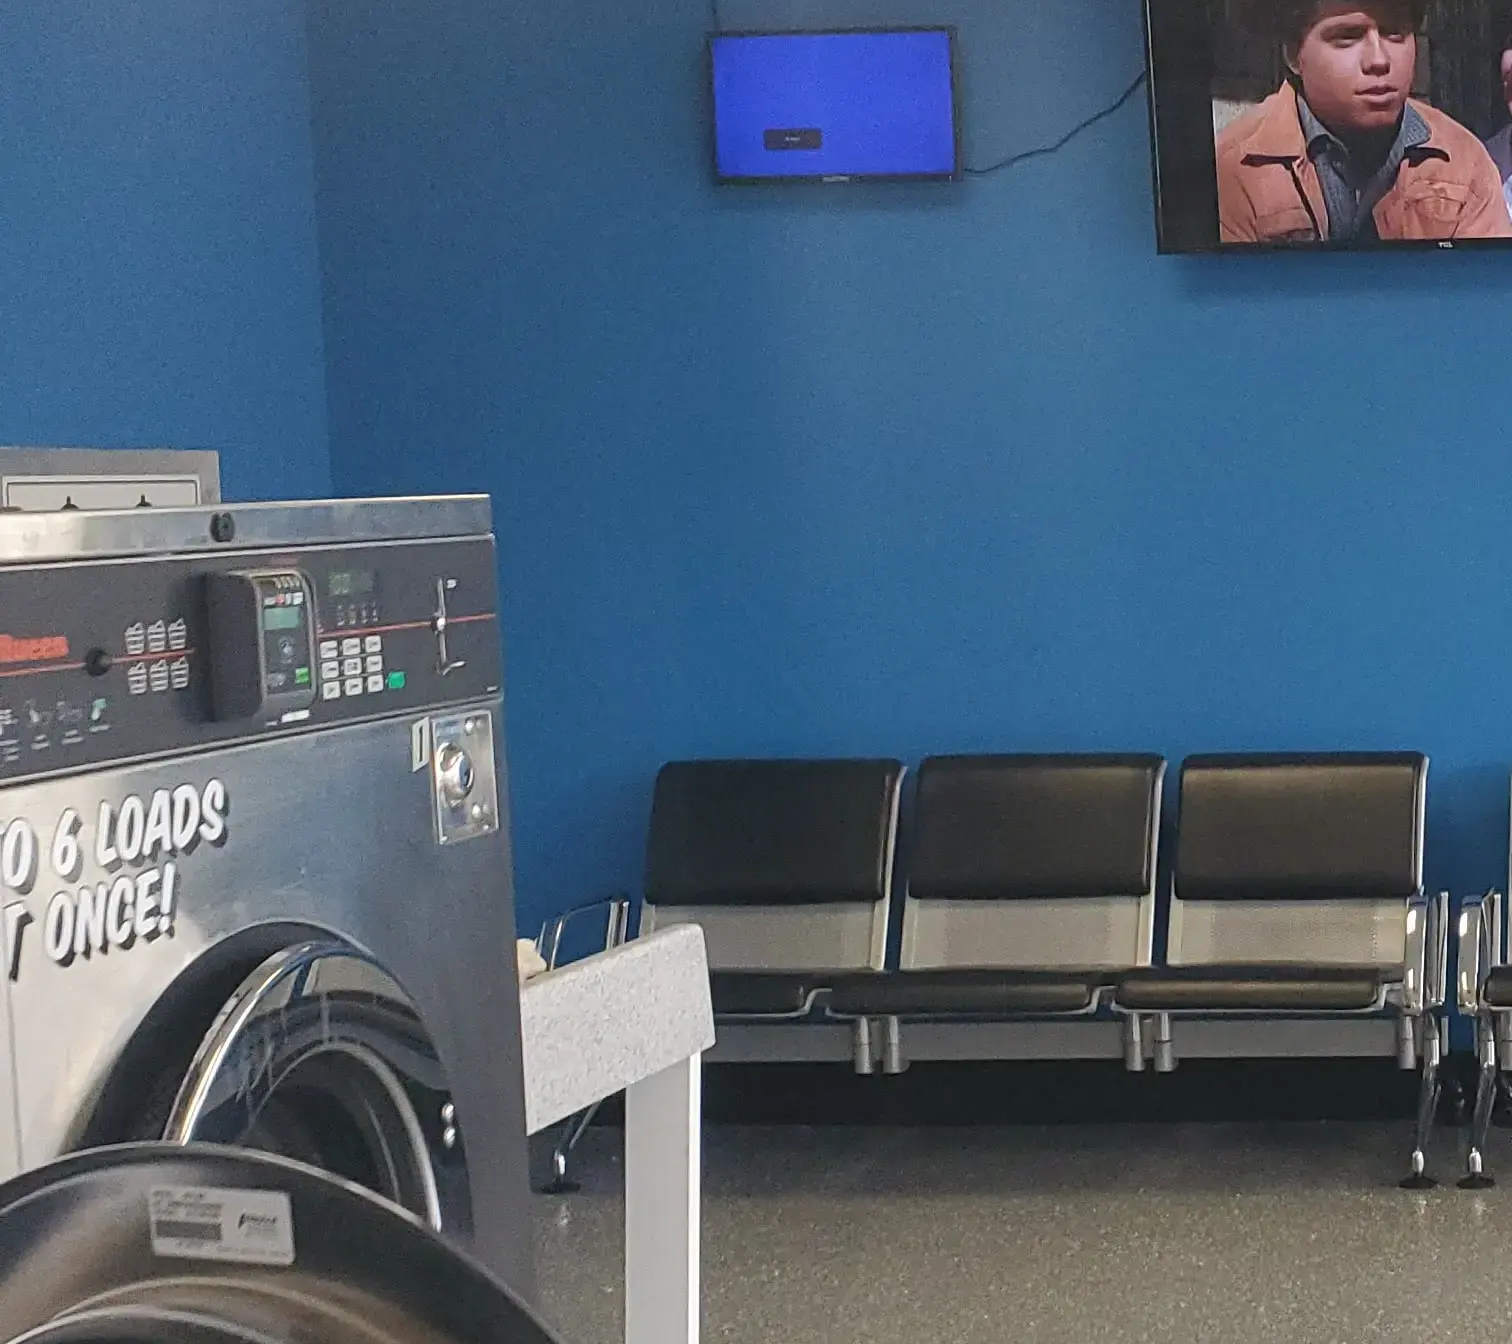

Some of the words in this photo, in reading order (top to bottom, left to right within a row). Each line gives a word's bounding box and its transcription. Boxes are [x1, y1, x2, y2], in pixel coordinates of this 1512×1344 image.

[0, 817, 36, 894] O
[53, 808, 82, 883] 6
[97, 778, 227, 873] LOADS
[46, 861, 179, 967] ONCE!
